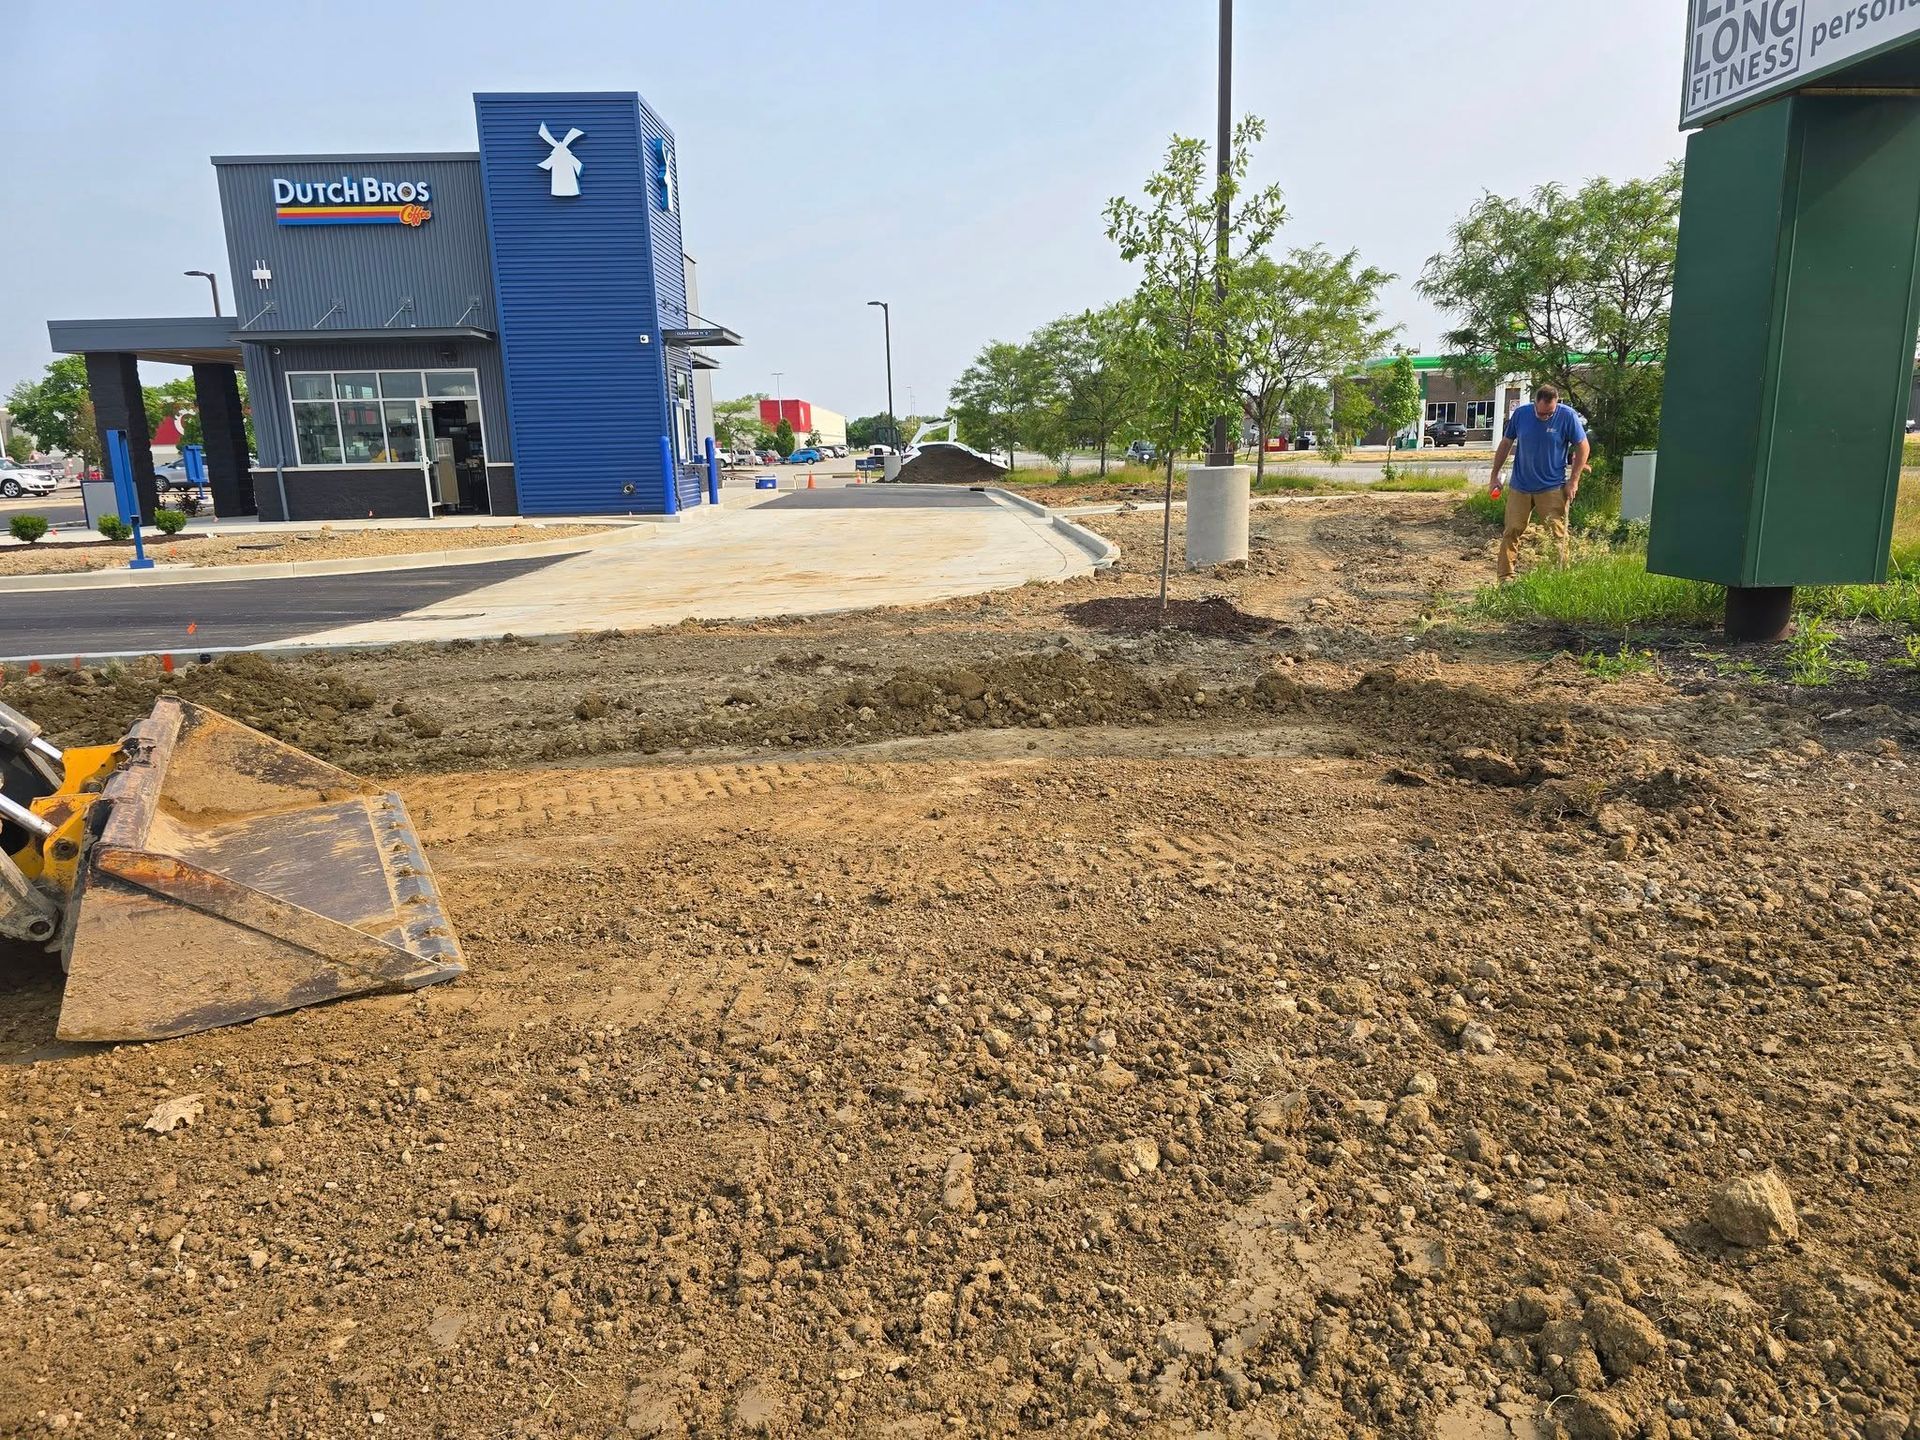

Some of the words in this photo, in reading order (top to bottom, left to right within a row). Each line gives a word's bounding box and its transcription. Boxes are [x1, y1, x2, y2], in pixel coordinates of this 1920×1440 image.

[1694, 0, 1797, 75] LONG
[1810, 0, 1920, 58] person
[1691, 37, 1794, 106] FITNESS
[273, 176, 360, 204] DUTCH
[362, 177, 430, 203] BROS
[399, 204, 431, 227] Coffee
